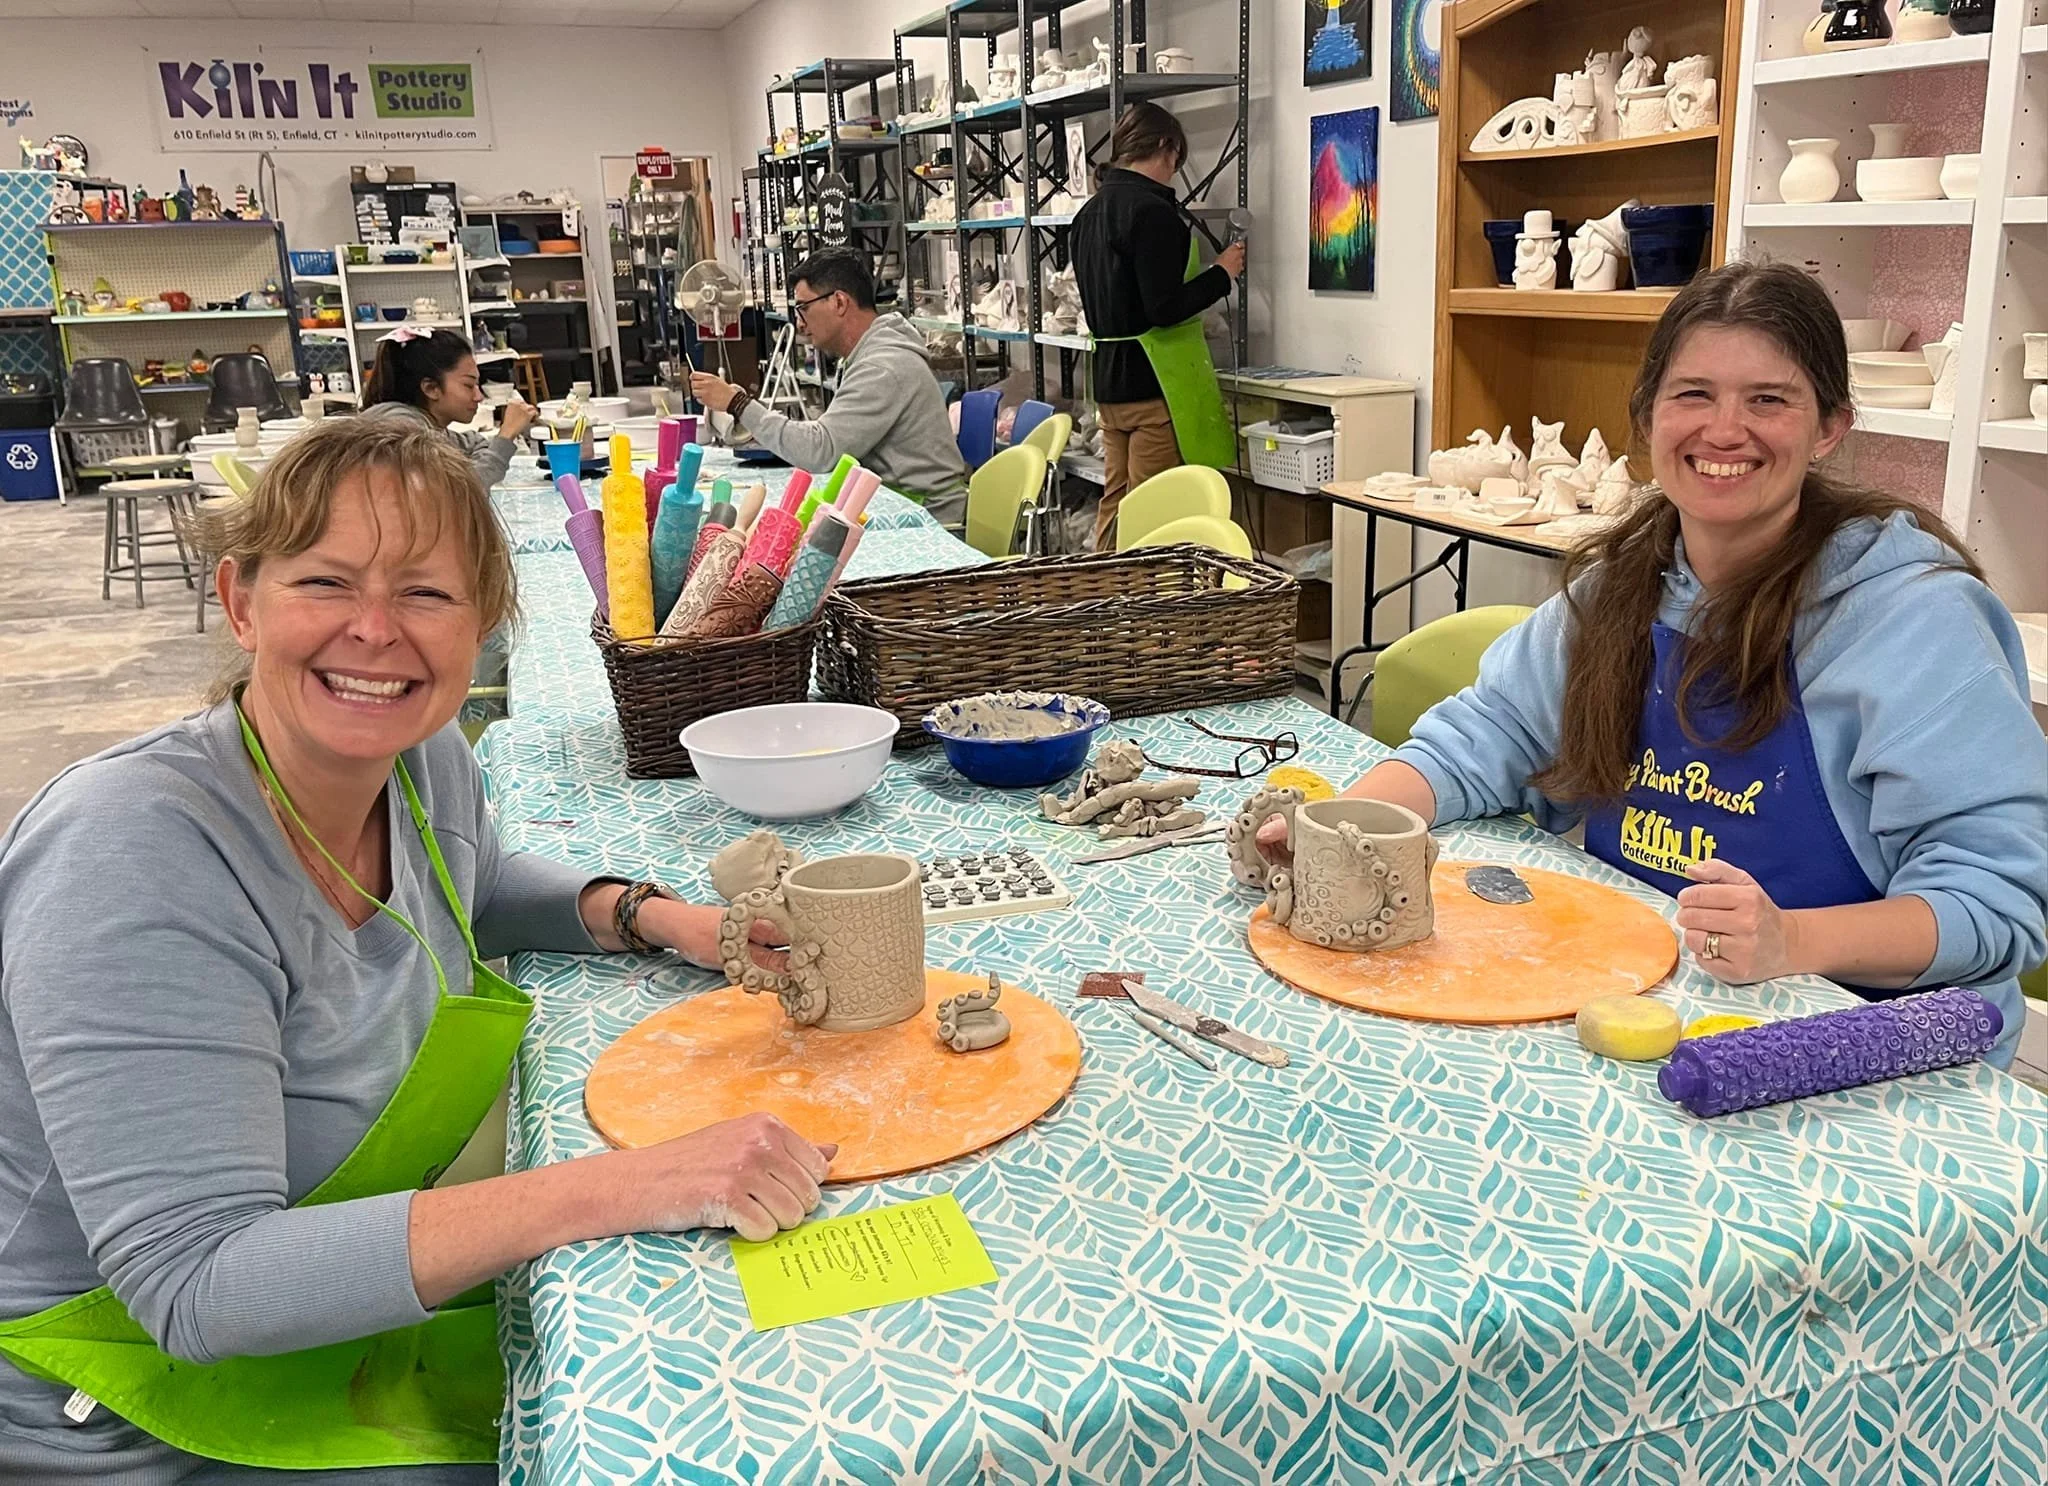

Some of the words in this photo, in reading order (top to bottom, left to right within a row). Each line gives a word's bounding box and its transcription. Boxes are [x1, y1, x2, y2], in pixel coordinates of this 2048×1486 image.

[158, 59, 299, 119] Kil'n
[308, 63, 359, 119] It
[377, 70, 467, 92] Pottery
[0, 99, 19, 108] est
[387, 91, 462, 111] Studio
[173, 129, 193, 140] 610
[195, 129, 232, 141] Enfield
[234, 130, 246, 141] St
[323, 130, 338, 141] CT
[355, 128, 477, 142] kilnitpotterystudio.com
[1640, 748, 1685, 796] Paint
[1684, 761, 1765, 816] Brush
[1622, 842, 1666, 869] Pottery
[1666, 855, 1688, 875] Stu
[1690, 825, 1718, 866] It
